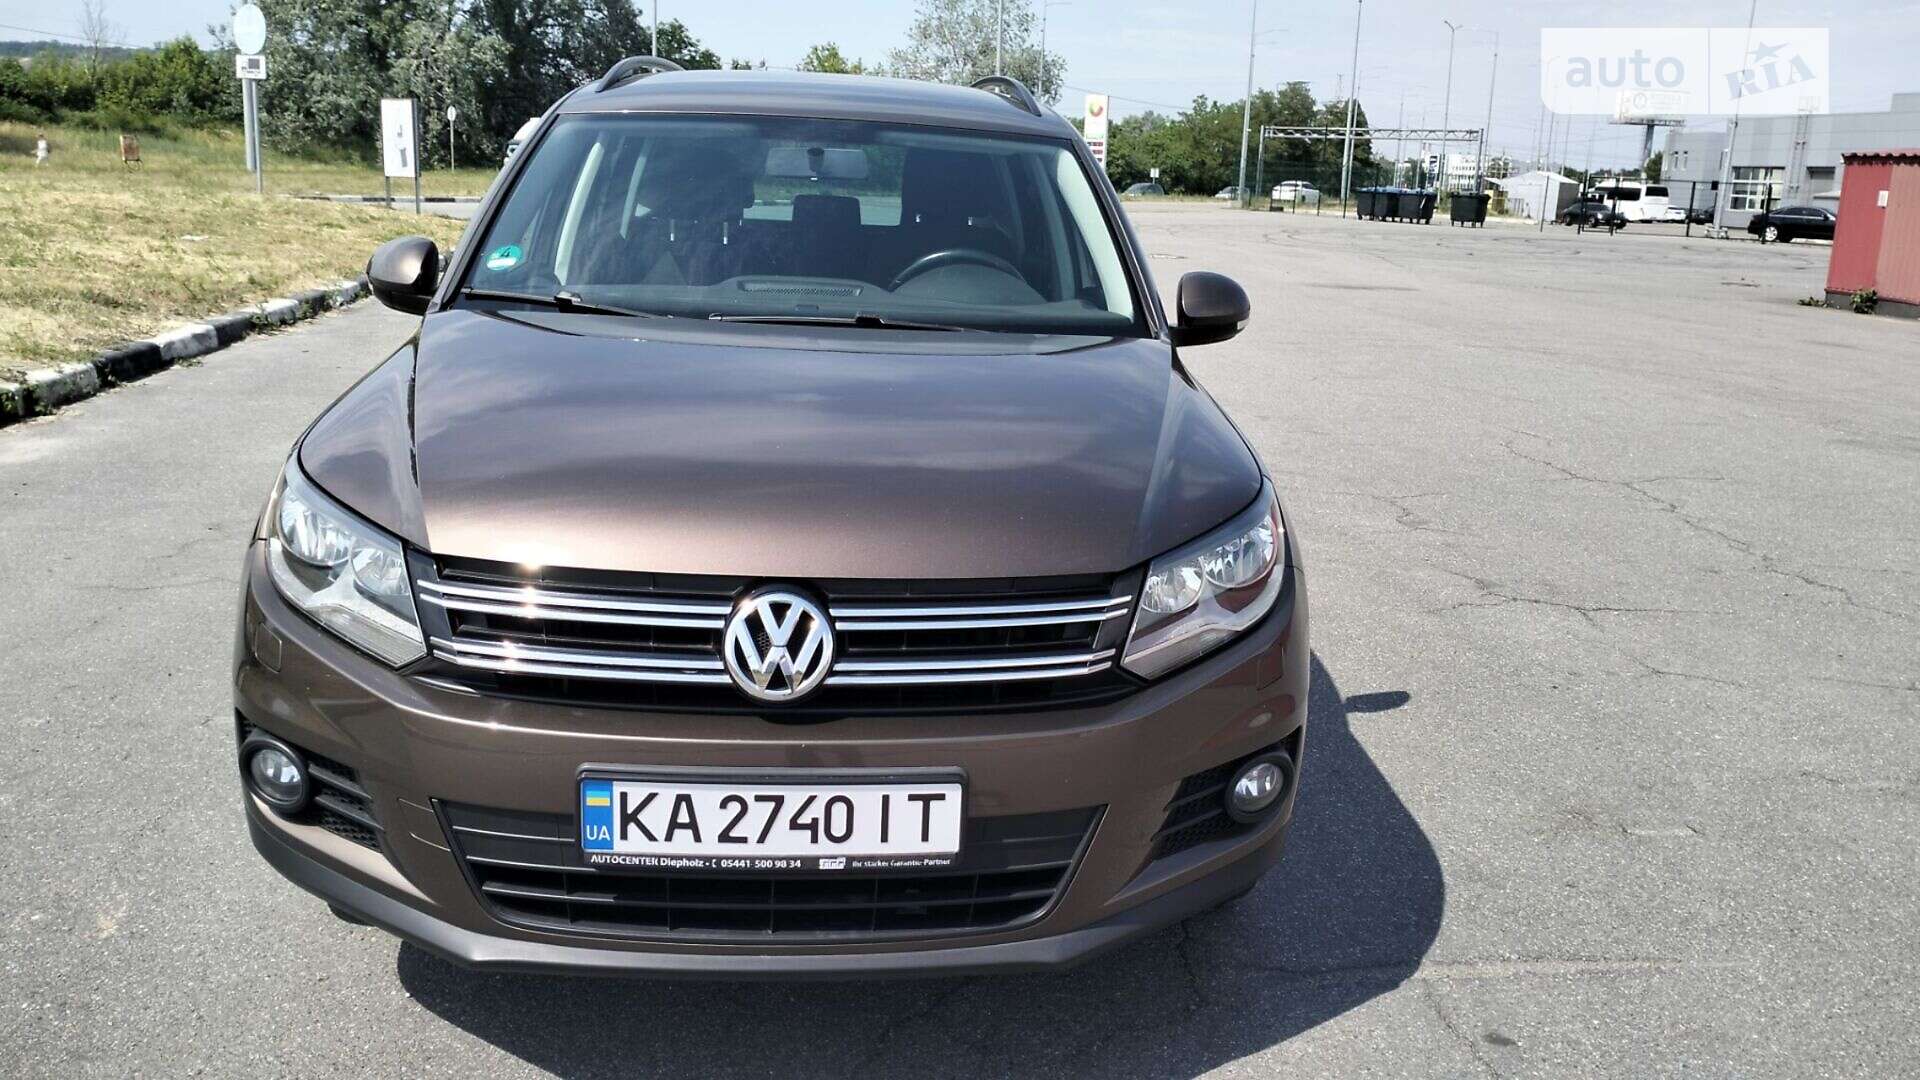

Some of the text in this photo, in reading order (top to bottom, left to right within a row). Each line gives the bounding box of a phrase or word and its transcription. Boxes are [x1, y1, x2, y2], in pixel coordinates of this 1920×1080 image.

[735, 600, 824, 692] VW
[586, 825, 611, 841] UA
[619, 792, 946, 844] KA 2740 IT
[659, 857, 704, 869] Diepholz
[788, 859, 801, 868] 34
